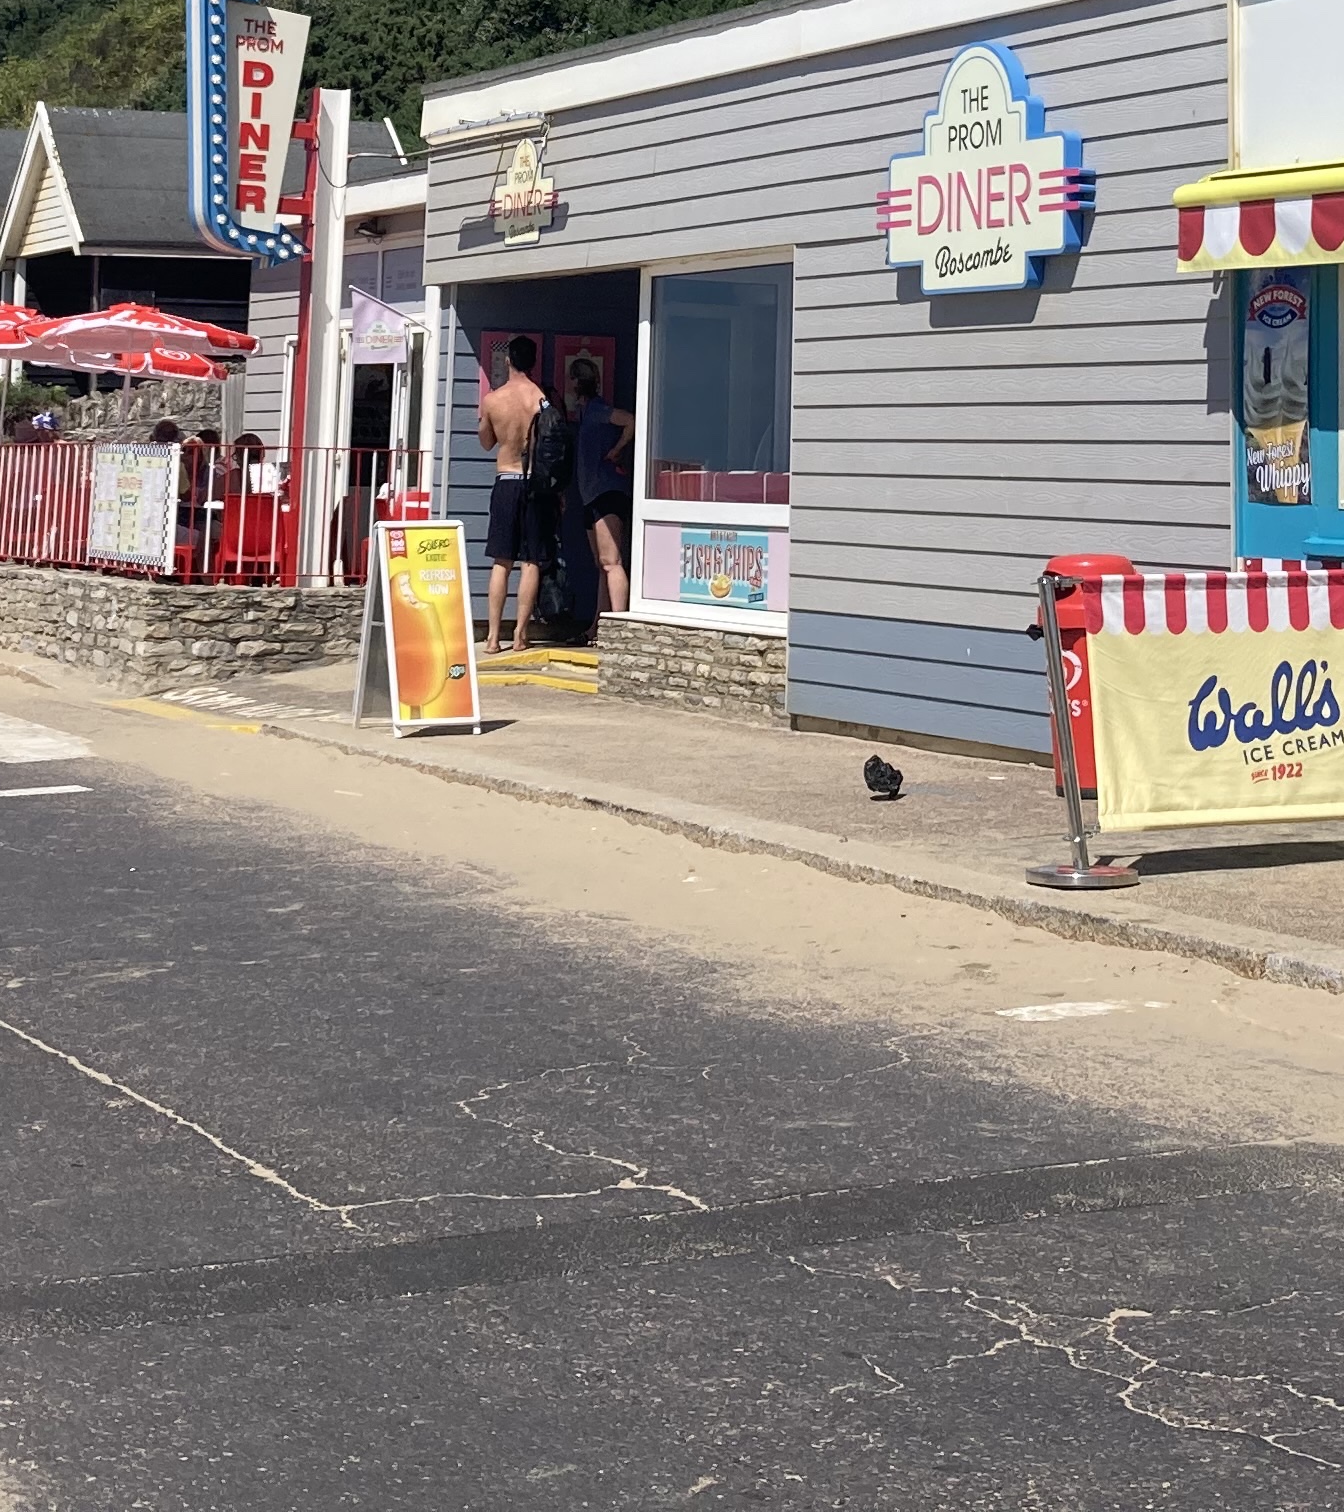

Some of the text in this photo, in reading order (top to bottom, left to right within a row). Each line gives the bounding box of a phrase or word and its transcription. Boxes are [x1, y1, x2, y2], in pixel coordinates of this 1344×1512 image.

[243, 18, 277, 37] THE
[235, 35, 284, 54] PROM
[961, 85, 989, 114] THE
[235, 60, 274, 213] DINER
[948, 118, 1002, 153] PROM
[514, 169, 534, 184] PROM
[503, 189, 543, 220] DINER
[917, 163, 1032, 236] DINER
[935, 236, 1013, 278] Boscombe
[1253, 290, 1303, 309] NEW FOREST
[1247, 440, 1294, 467] New Forest
[1256, 461, 1310, 498] Whippy
[419, 568, 456, 581] REFRESH
[683, 543, 712, 580] FISH
[724, 544, 763, 581] CHIPS
[428, 583, 449, 595] NOW
[1188, 659, 1341, 752] Wall's
[1243, 745, 1274, 765] ICE
[1271, 762, 1303, 781] 1922
